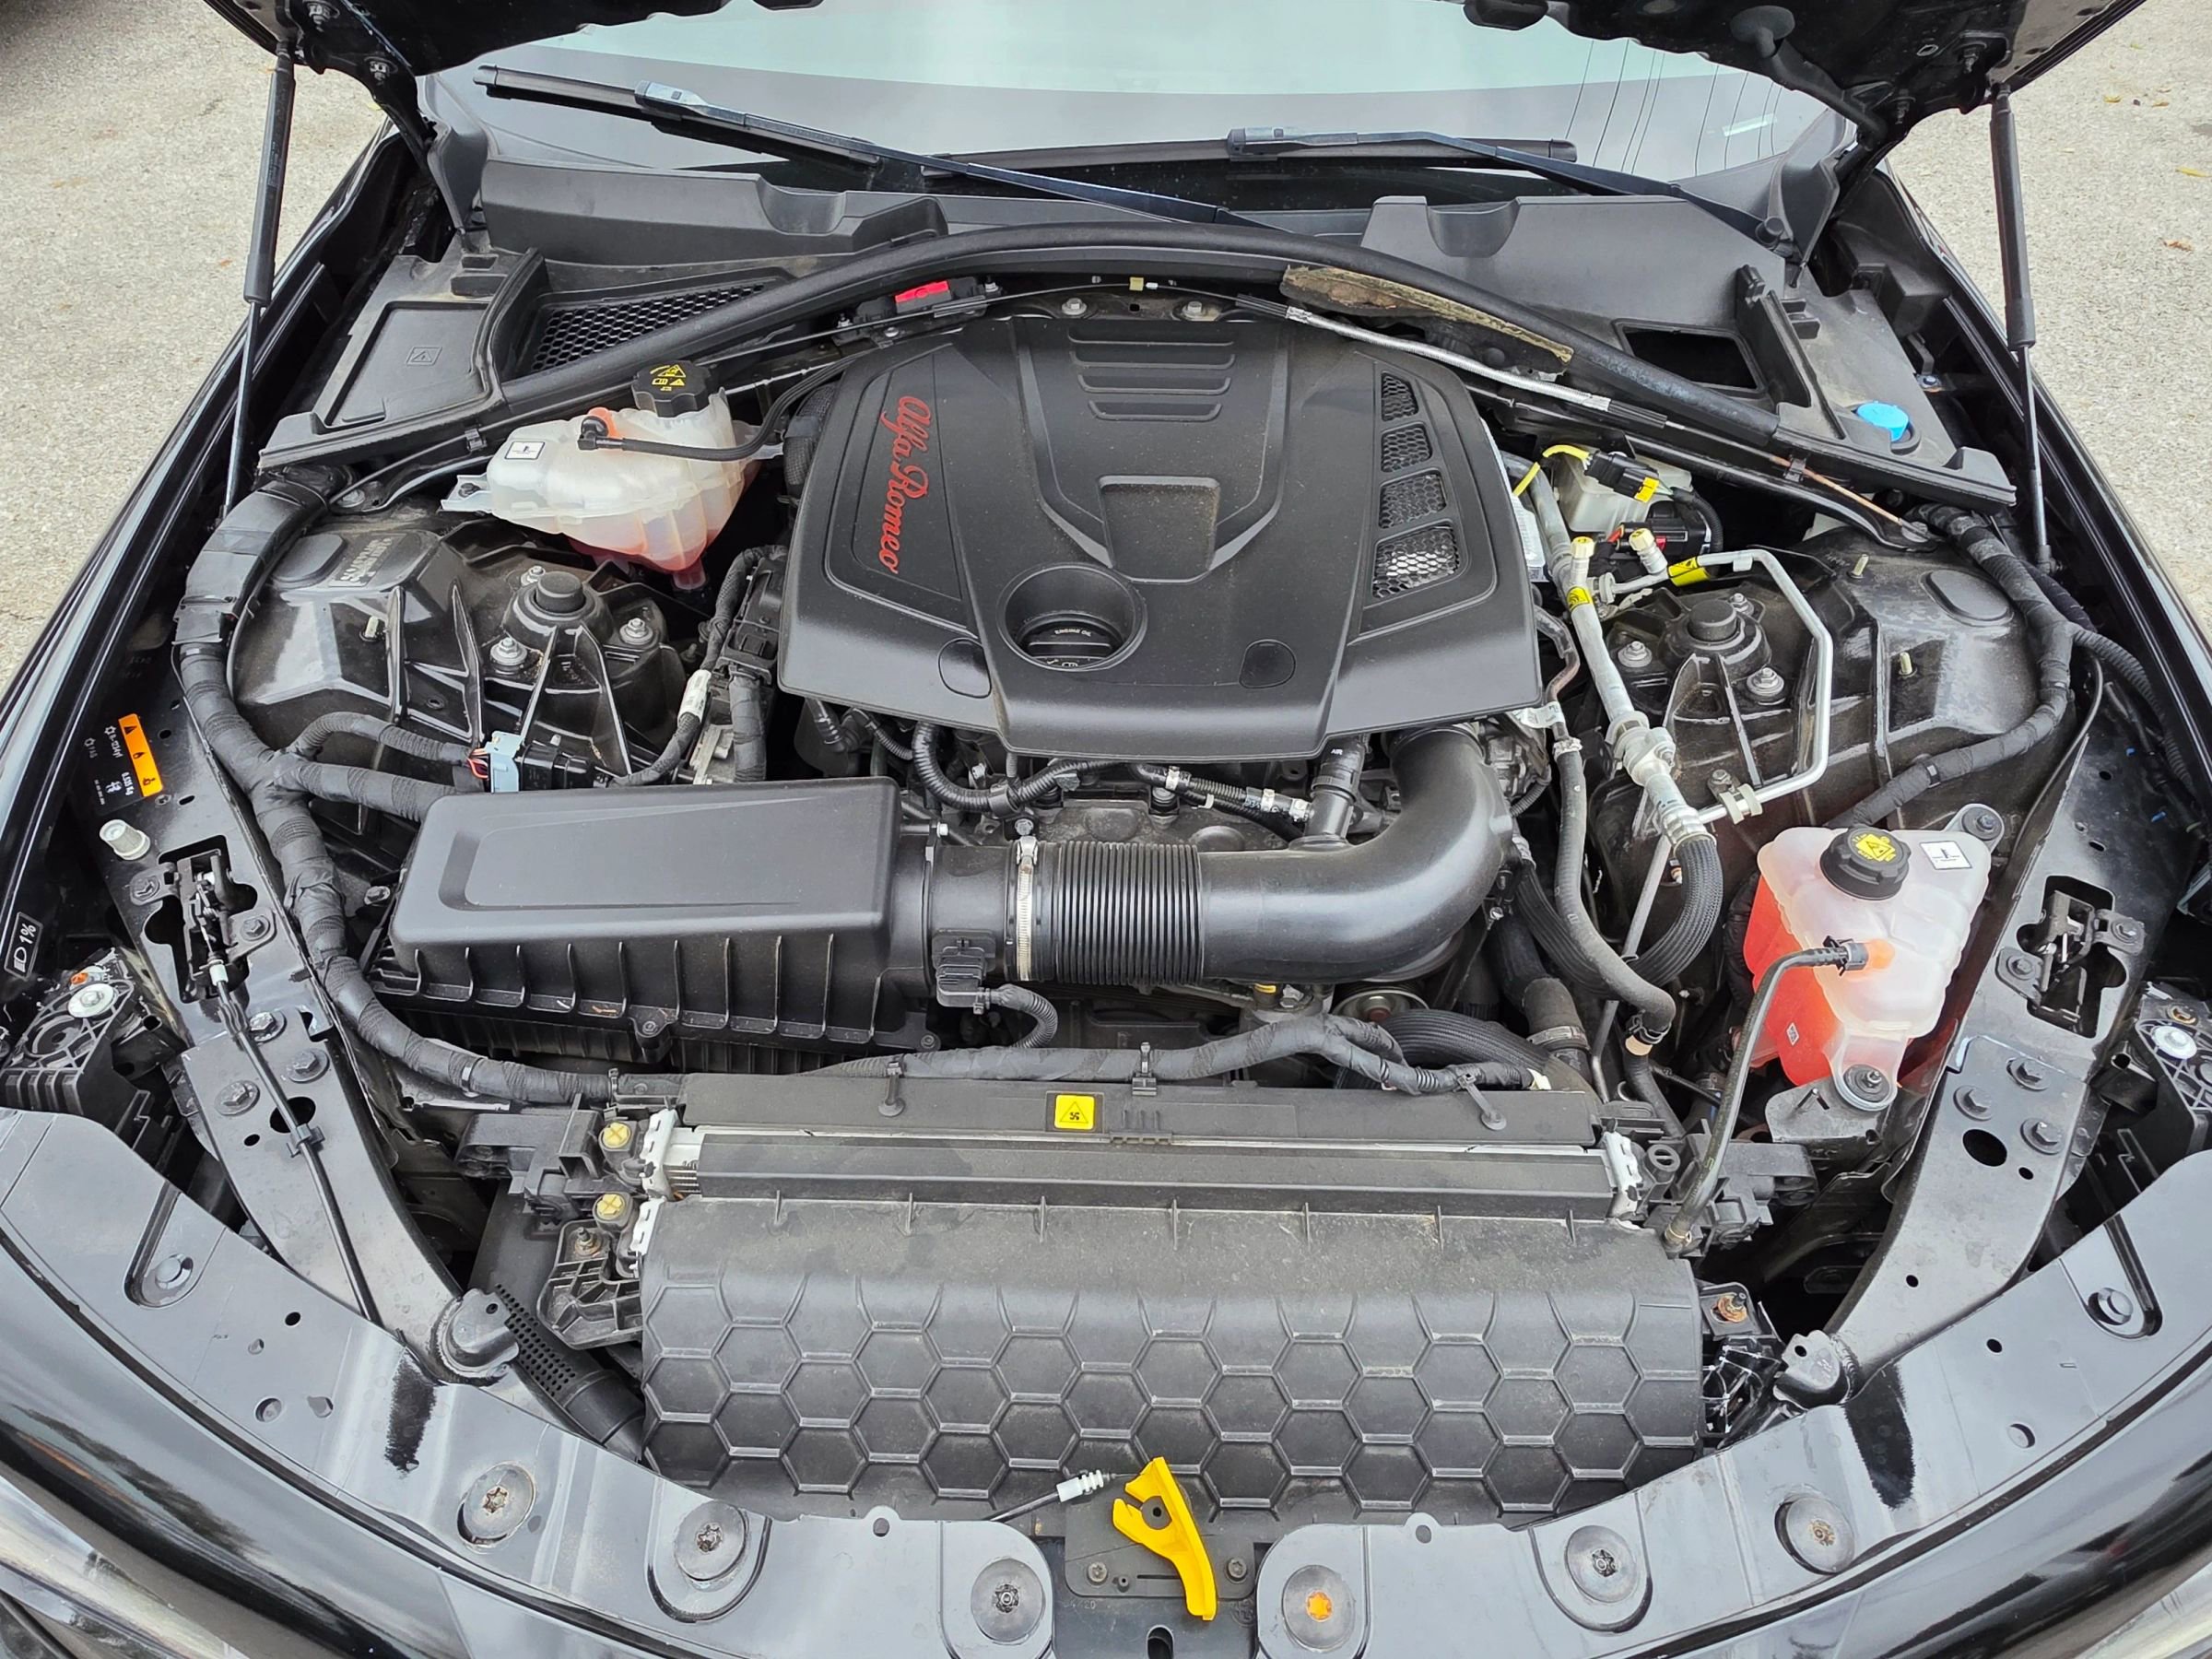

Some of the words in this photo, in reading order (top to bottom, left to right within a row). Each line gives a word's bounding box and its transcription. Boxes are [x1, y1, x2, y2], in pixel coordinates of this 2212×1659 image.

[879, 395, 931, 462] Alfa
[878, 460, 929, 575] Romeo
[18, 923, 37, 945] 1%
